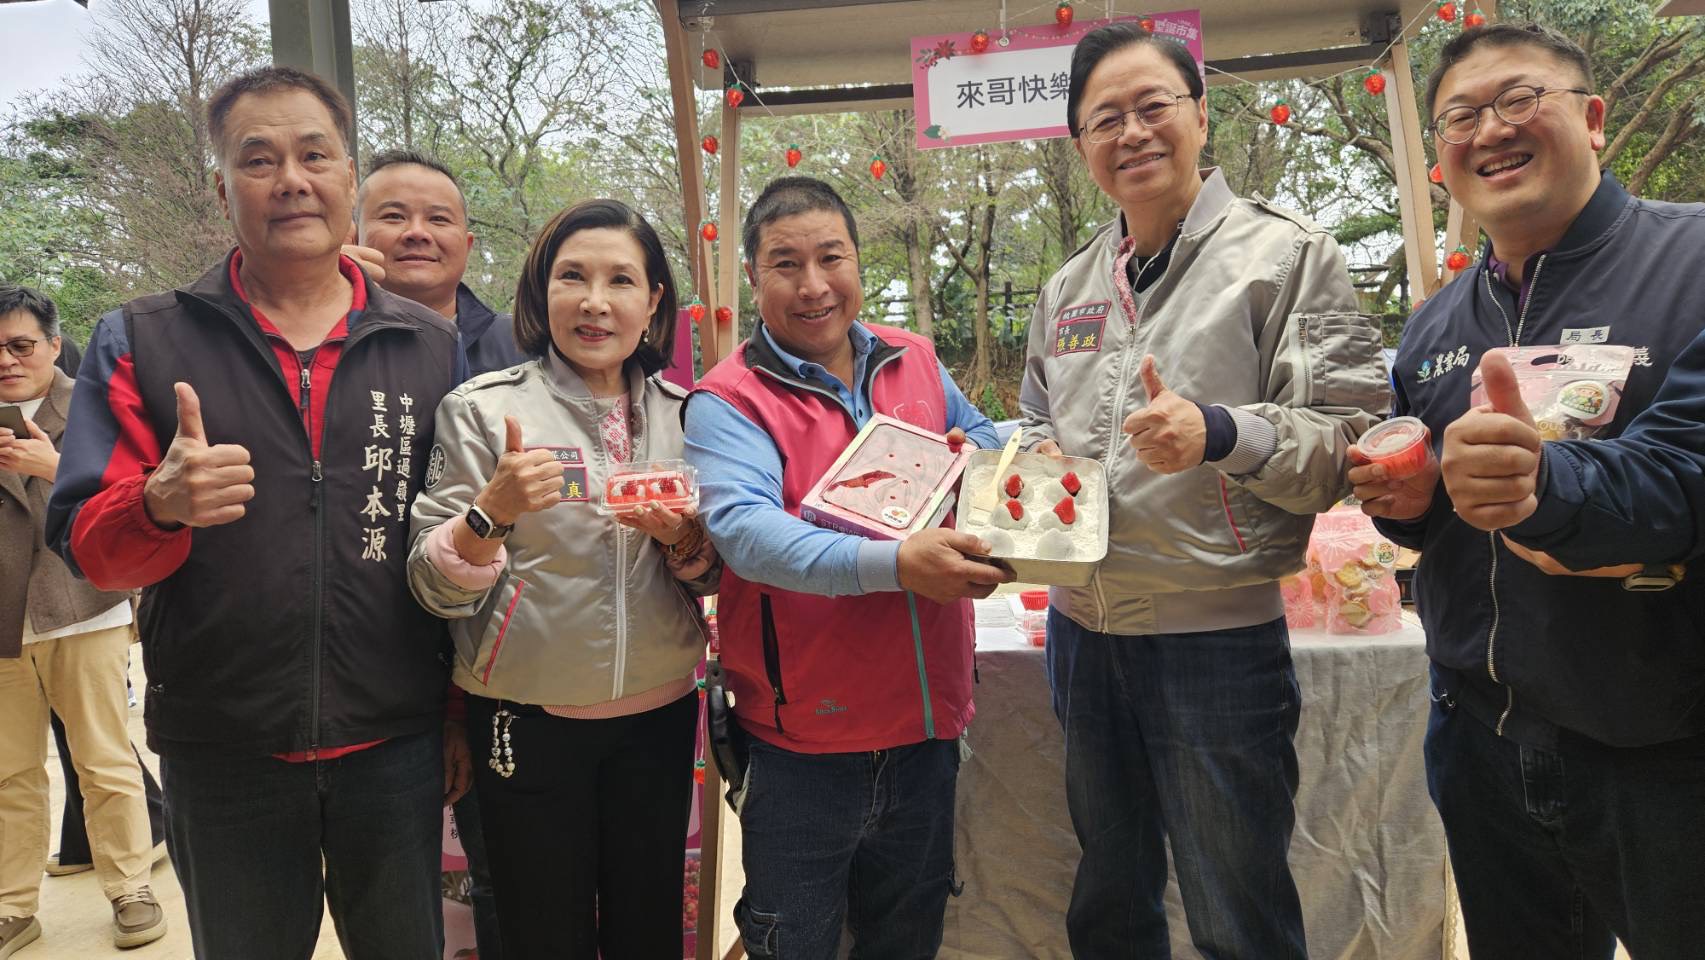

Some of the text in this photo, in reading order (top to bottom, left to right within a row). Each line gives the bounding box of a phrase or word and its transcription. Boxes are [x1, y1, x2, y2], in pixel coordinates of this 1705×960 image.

[956, 72, 1071, 109] 來哥快樂
[1565, 327, 1604, 343] 局長
[1433, 345, 1470, 378] 農業局
[395, 393, 416, 522] 中壢區過嶺里
[360, 390, 394, 562] 里長邱本源
[567, 481, 582, 498] 真
